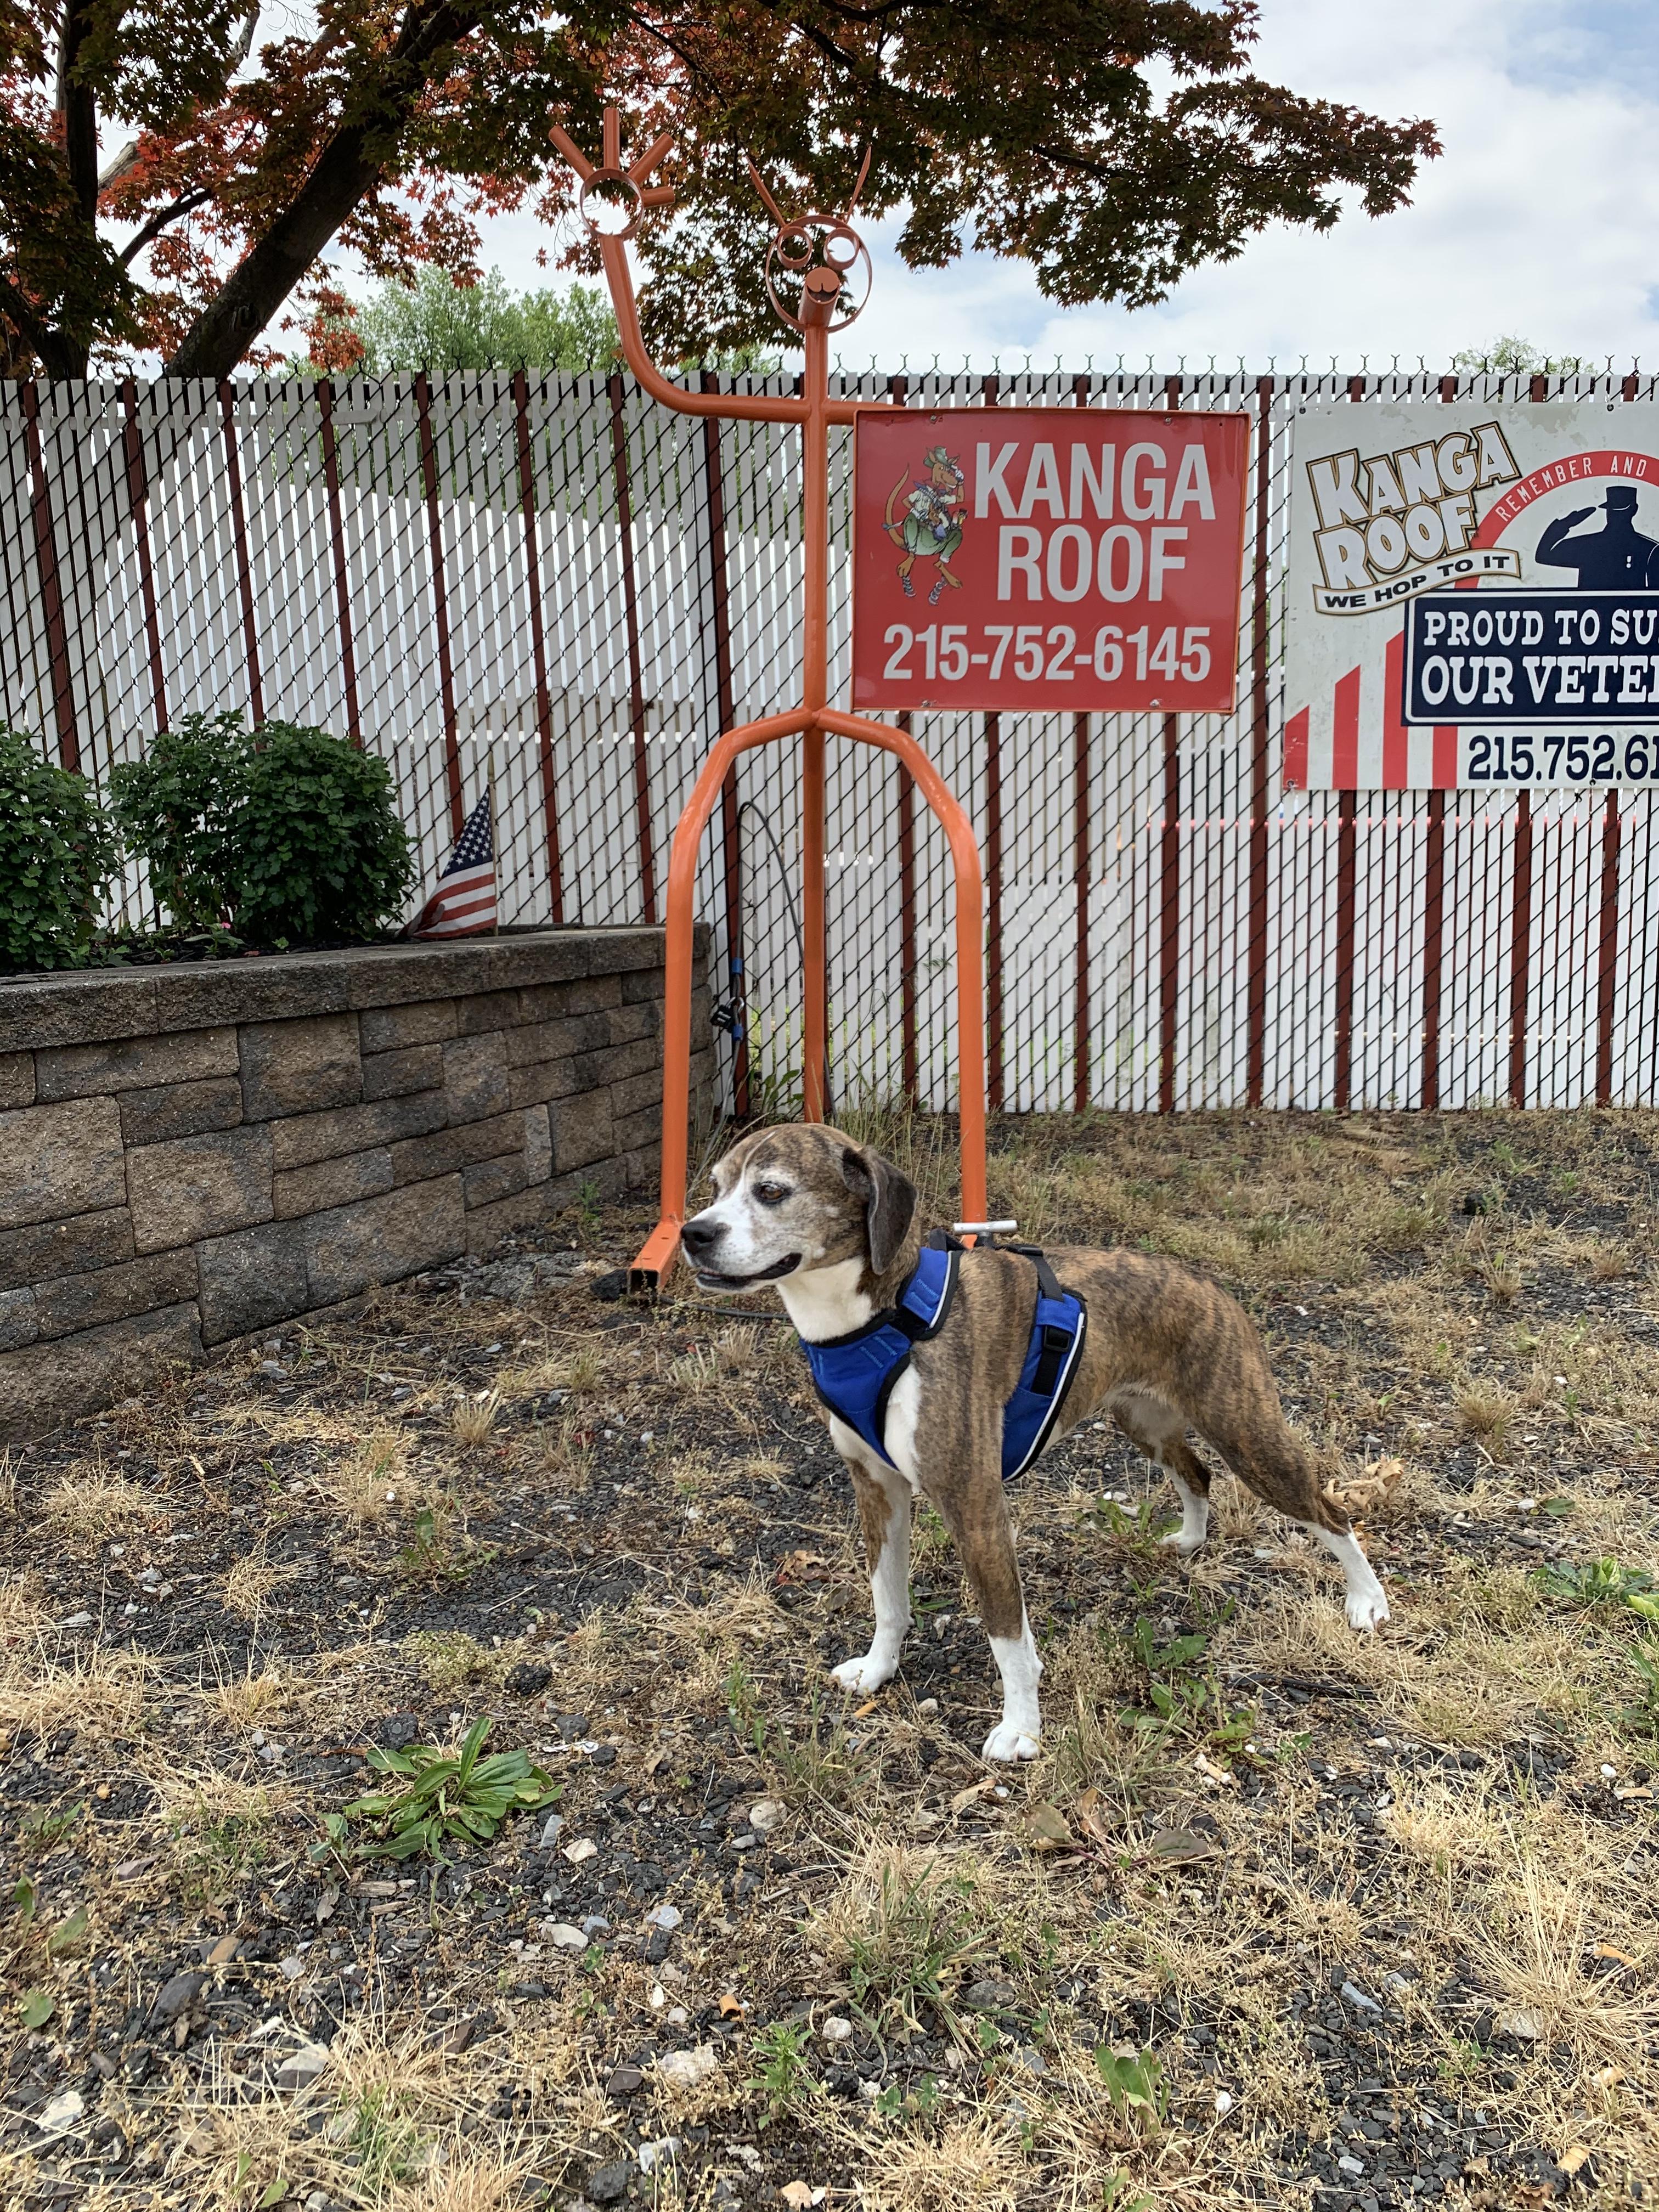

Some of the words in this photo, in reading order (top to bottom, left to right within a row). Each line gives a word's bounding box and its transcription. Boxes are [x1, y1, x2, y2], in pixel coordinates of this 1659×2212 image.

[974, 442, 1216, 521] KANGA
[1306, 421, 1522, 531] KANGA
[1496, 457, 1592, 522] REMEMBER
[1610, 455, 1647, 477] AND
[997, 524, 1188, 602] ROOF
[1313, 495, 1476, 591] ROOF
[1324, 595, 1367, 608] WE
[1374, 575, 1426, 602] HOP
[1437, 558, 1474, 577] TO
[1483, 556, 1510, 569] IT
[883, 624, 1211, 682] 215-752-6145
[1424, 610, 1544, 646] PROUD
[1555, 609, 1600, 645] TO
[1610, 608, 1659, 645] SU
[1421, 655, 1514, 706] OUR
